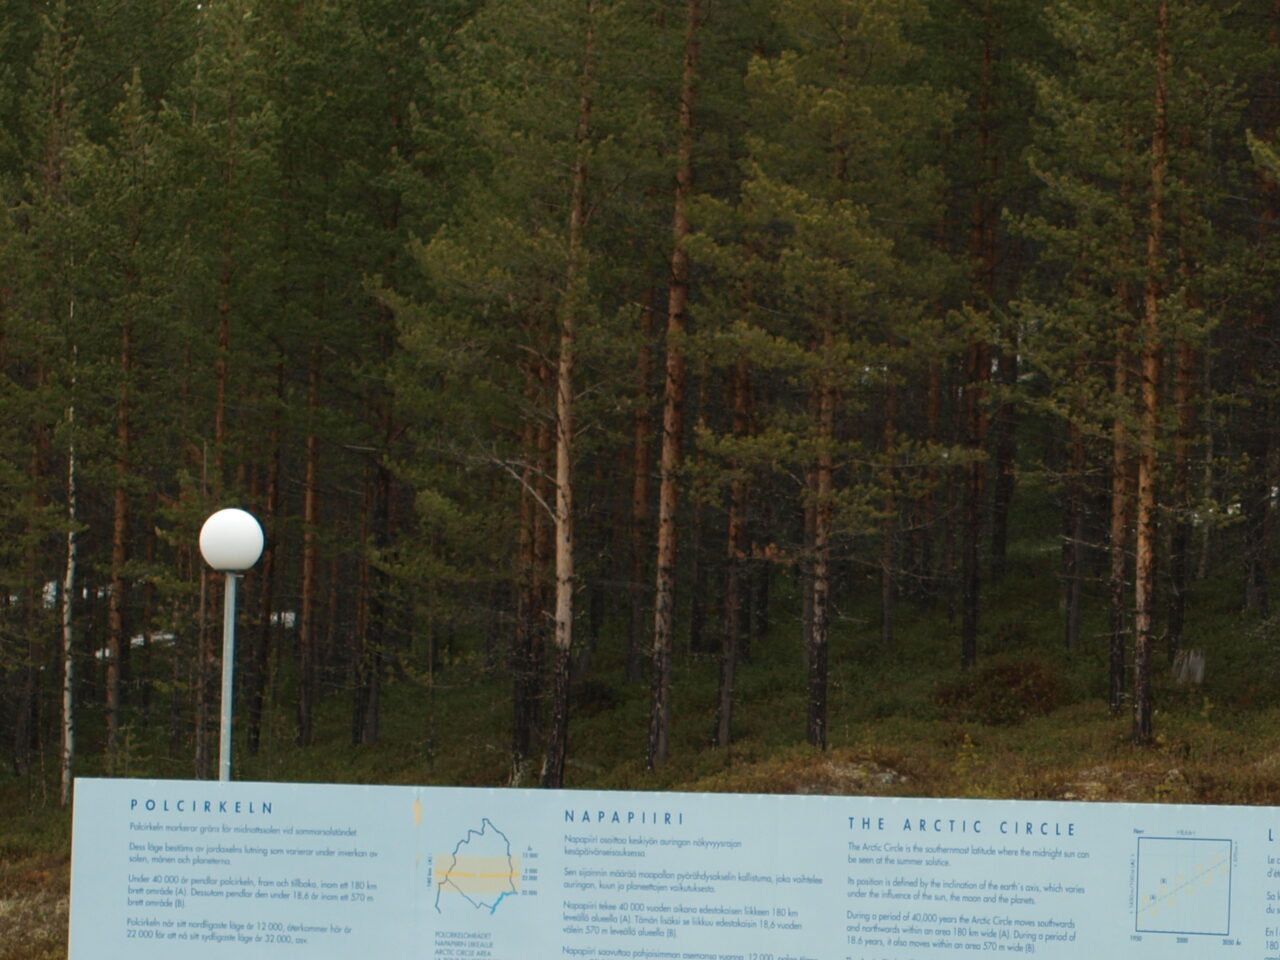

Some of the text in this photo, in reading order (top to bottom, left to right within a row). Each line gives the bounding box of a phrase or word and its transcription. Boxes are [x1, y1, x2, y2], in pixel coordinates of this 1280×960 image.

[130, 798, 274, 815] POLCIRKELN
[564, 810, 685, 825] NAPAPIIRI
[848, 817, 1077, 836] THE ARCTIC CIRCLE
[848, 841, 860, 850] The
[862, 841, 881, 851] Arctic
[883, 842, 903, 851] Circle
[912, 843, 923, 852] the
[971, 845, 996, 855] latitude
[997, 846, 1018, 855] where
[1020, 847, 1030, 856] the
[1032, 847, 1062, 859] midnight
[884, 855, 894, 864] the
[856, 876, 882, 887] position
[892, 877, 918, 886] defined
[930, 879, 940, 887] the
[942, 879, 977, 889] inclination
[988, 881, 998, 889] the
[1043, 883, 1063, 892] which
[1065, 884, 1084, 893] varies
[848, 889, 866, 897] under
[868, 890, 879, 898] the
[882, 890, 911, 899] influence
[922, 891, 932, 900] the
[950, 893, 960, 901] the
[982, 894, 996, 902] and
[998, 894, 1008, 902] the
[847, 910, 870, 921] During
[878, 911, 900, 923] period
[938, 916, 957, 925] years
[958, 914, 969, 923] the
[971, 915, 990, 924] Arctic
[992, 916, 1012, 925] Circle
[1037, 918, 1074, 928] southwards
[846, 922, 860, 931] and
[861, 923, 900, 933] northwards
[902, 925, 922, 934] within
[954, 927, 966, 936] 180
[980, 928, 996, 937] wide
[1013, 930, 1036, 941] During
[1044, 931, 1067, 942] period
